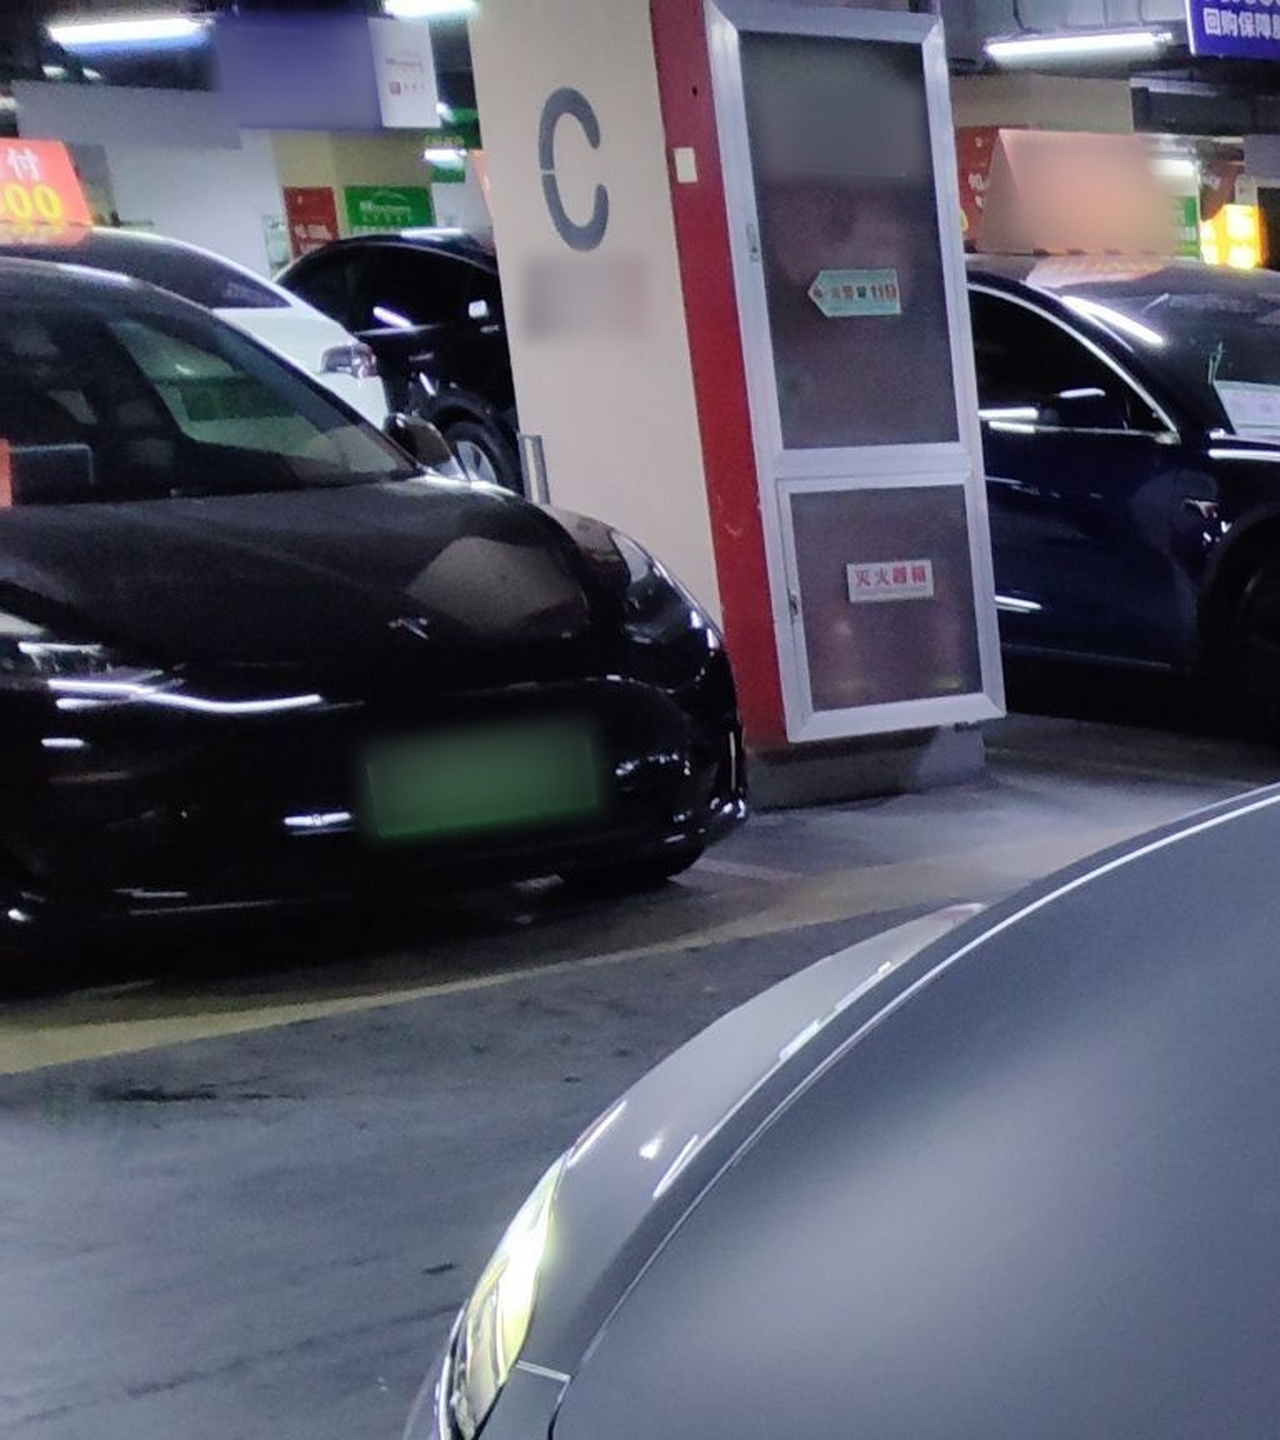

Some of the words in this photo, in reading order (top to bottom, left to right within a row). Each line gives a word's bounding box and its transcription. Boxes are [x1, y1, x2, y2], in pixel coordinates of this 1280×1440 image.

[538, 86, 609, 252] C
[855, 565, 926, 587] 灭火器箱
